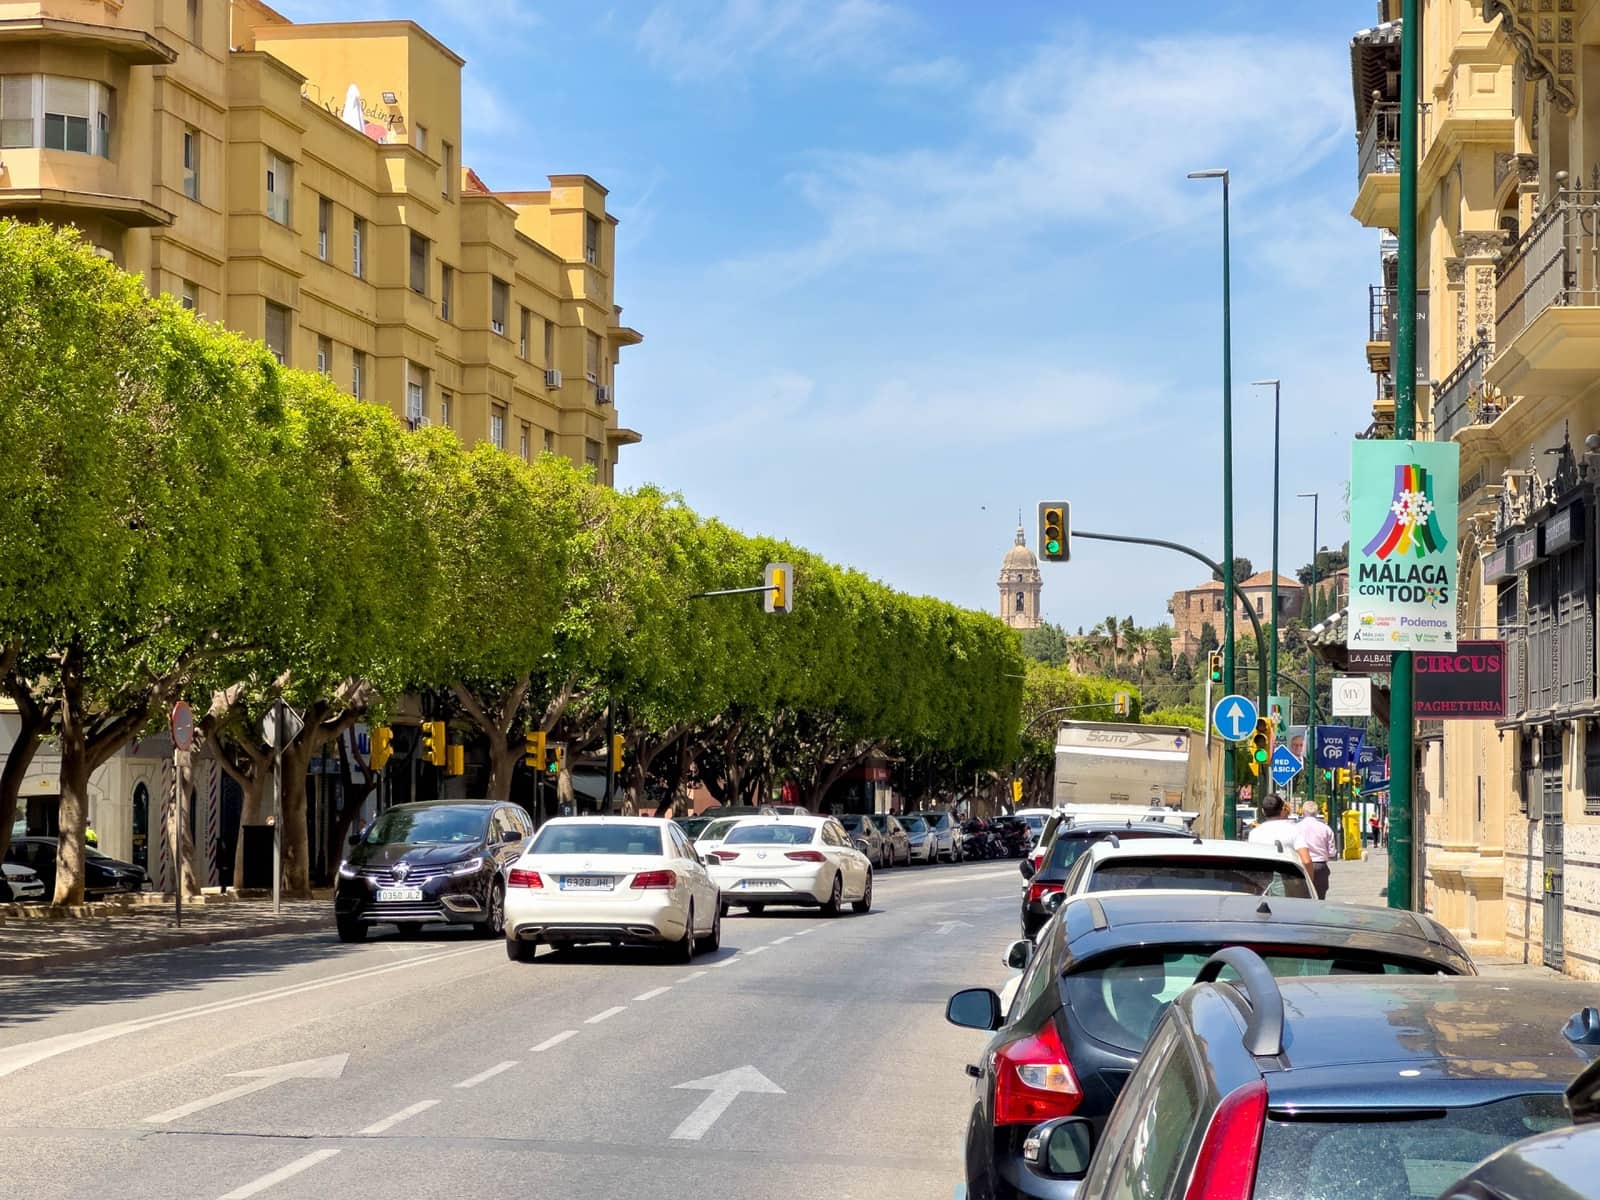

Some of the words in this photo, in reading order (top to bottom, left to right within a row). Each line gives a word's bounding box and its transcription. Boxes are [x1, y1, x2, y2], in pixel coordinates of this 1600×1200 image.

[1359, 559, 1448, 584] MÁLAGA
[1359, 585, 1384, 595] CON
[1400, 616, 1448, 627] Podemos
[1350, 654, 1361, 663] LA
[1414, 655, 1500, 673] CIRCUS
[1414, 701, 1502, 711] PAGHETTERIA
[1323, 737, 1344, 745] VOTA
